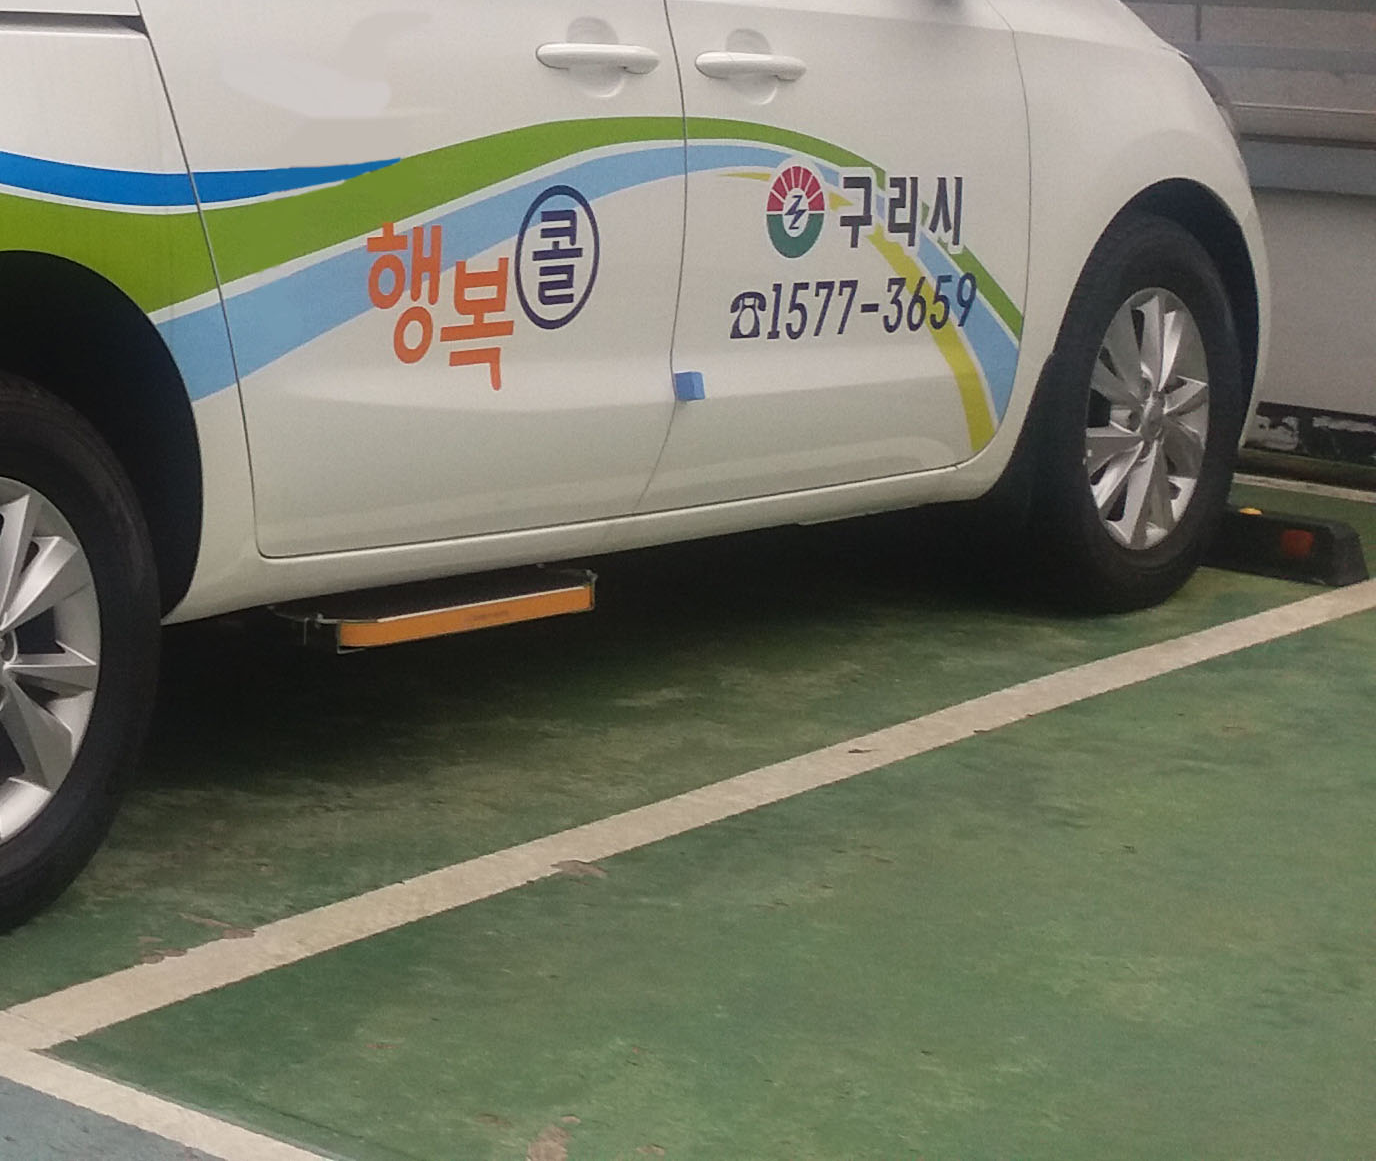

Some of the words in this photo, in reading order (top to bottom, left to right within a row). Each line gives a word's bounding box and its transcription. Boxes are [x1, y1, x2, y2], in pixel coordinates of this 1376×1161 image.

[840, 177, 962, 248] 구리시
[366, 222, 514, 391] 행복
[532, 209, 583, 305] 콜
[767, 272, 977, 339] 1577-3659
